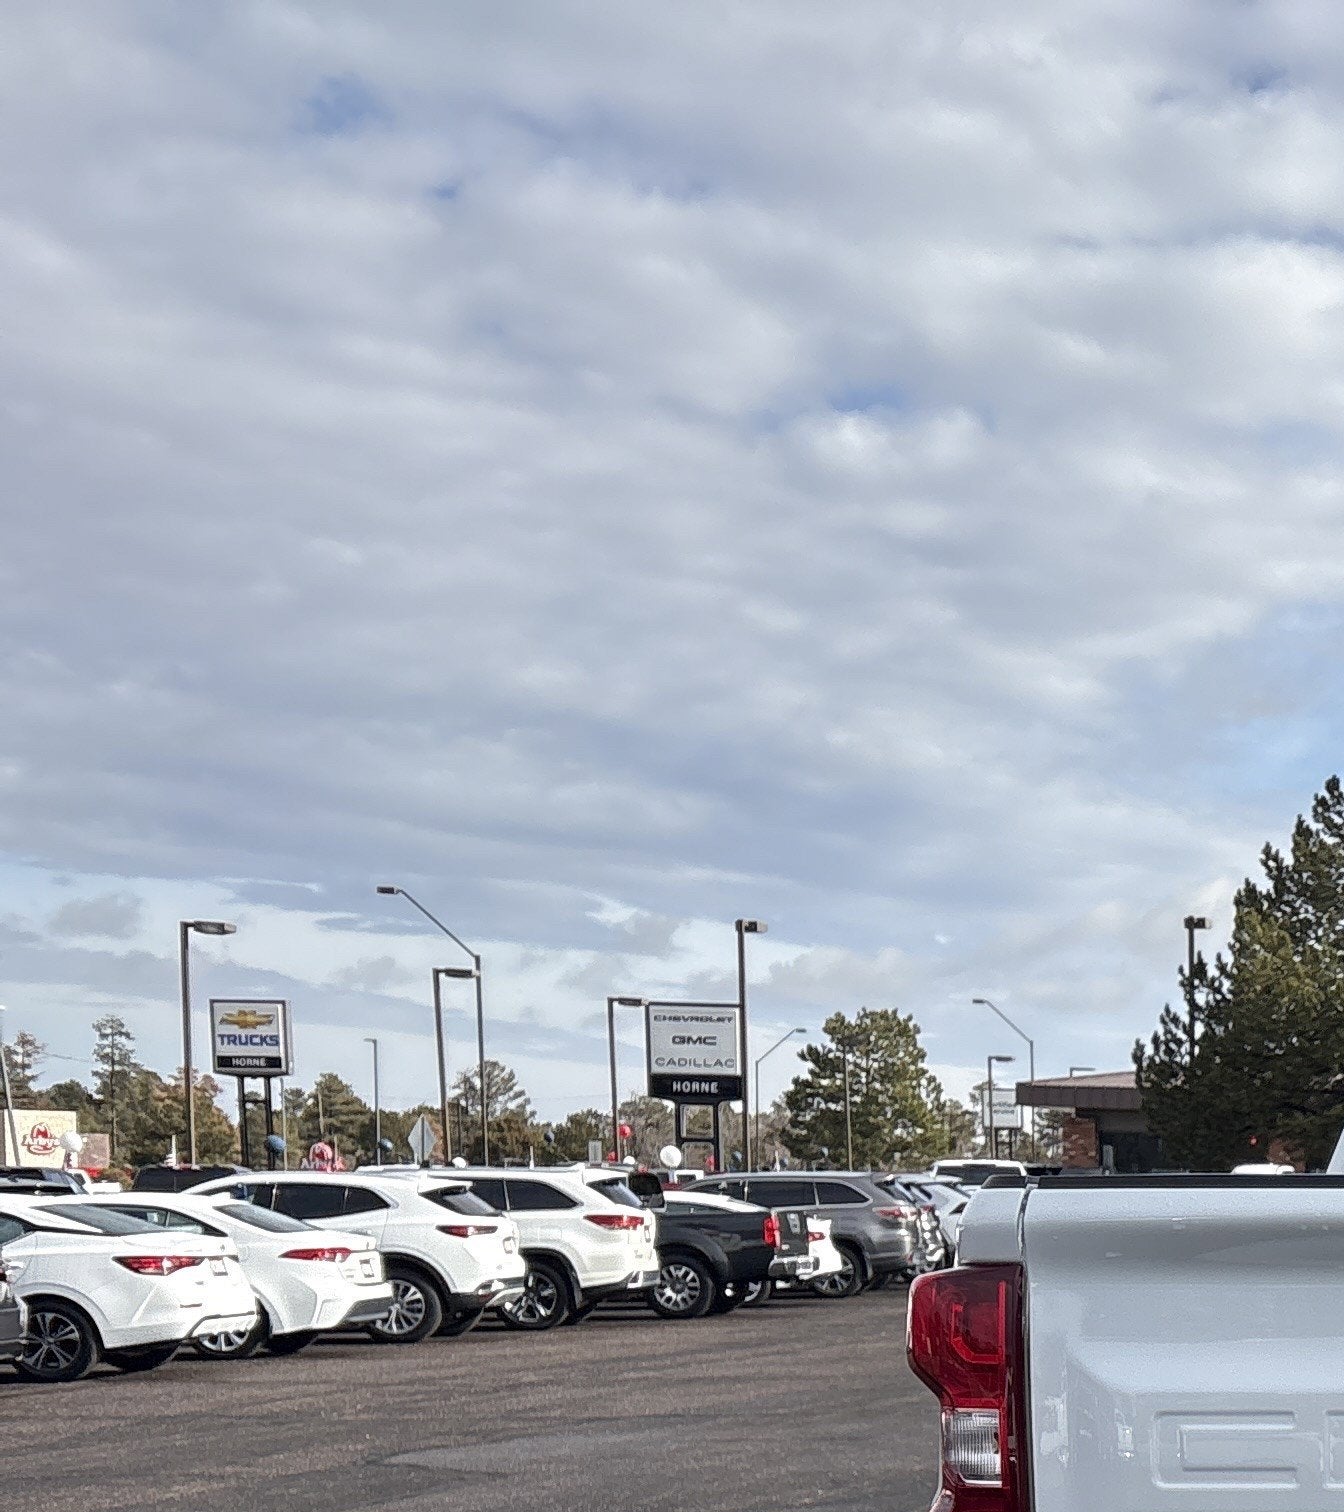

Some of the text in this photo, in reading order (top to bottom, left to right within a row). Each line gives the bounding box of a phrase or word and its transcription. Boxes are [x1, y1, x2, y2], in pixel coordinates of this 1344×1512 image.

[653, 1014, 734, 1024] CHEVROLET
[217, 1033, 280, 1047] TRUCKS
[671, 1035, 717, 1046] GMC
[231, 1057, 267, 1067] HORNE
[655, 1057, 735, 1069] CADILLAC
[672, 1080, 719, 1094] HORNE
